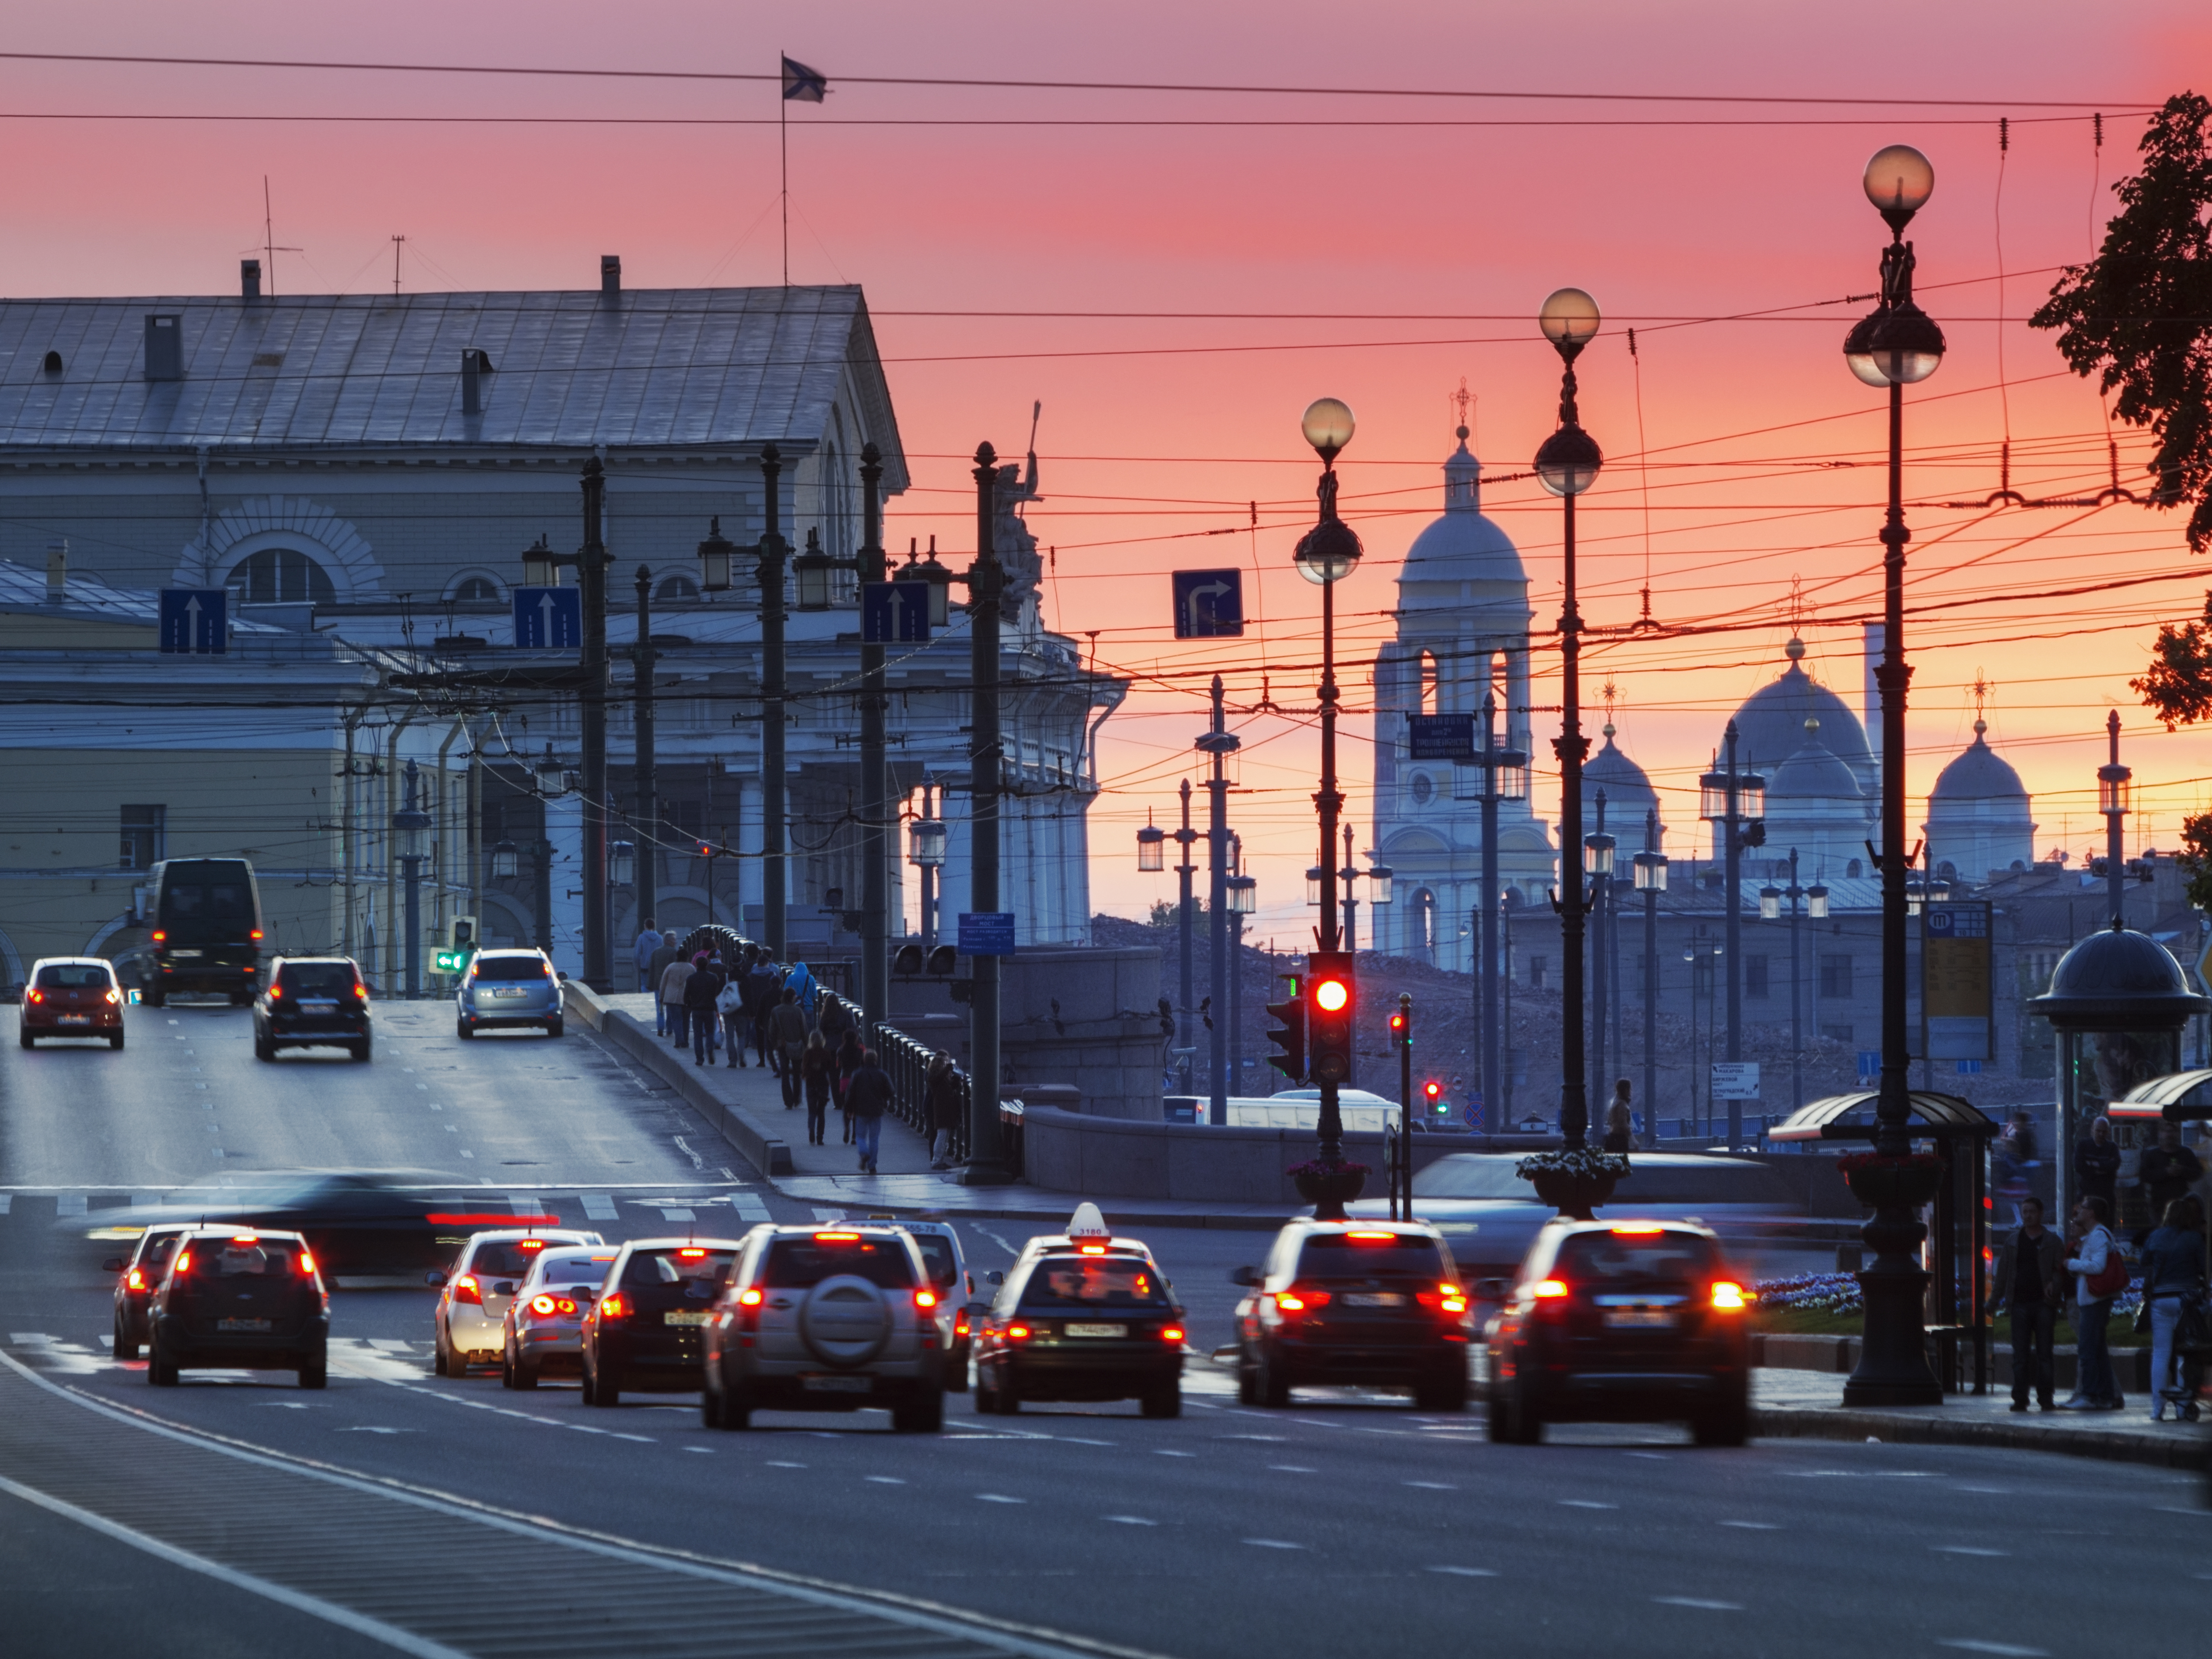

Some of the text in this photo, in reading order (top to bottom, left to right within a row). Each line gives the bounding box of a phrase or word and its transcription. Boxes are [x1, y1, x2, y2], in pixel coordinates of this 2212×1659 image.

[1415, 716, 1468, 726] ОСТАНОВКА
[1416, 737, 1469, 747] ТРОЛЛЕЙБУСОВ
[1416, 748, 1469, 756] ОДНОВРЕМЕННО
